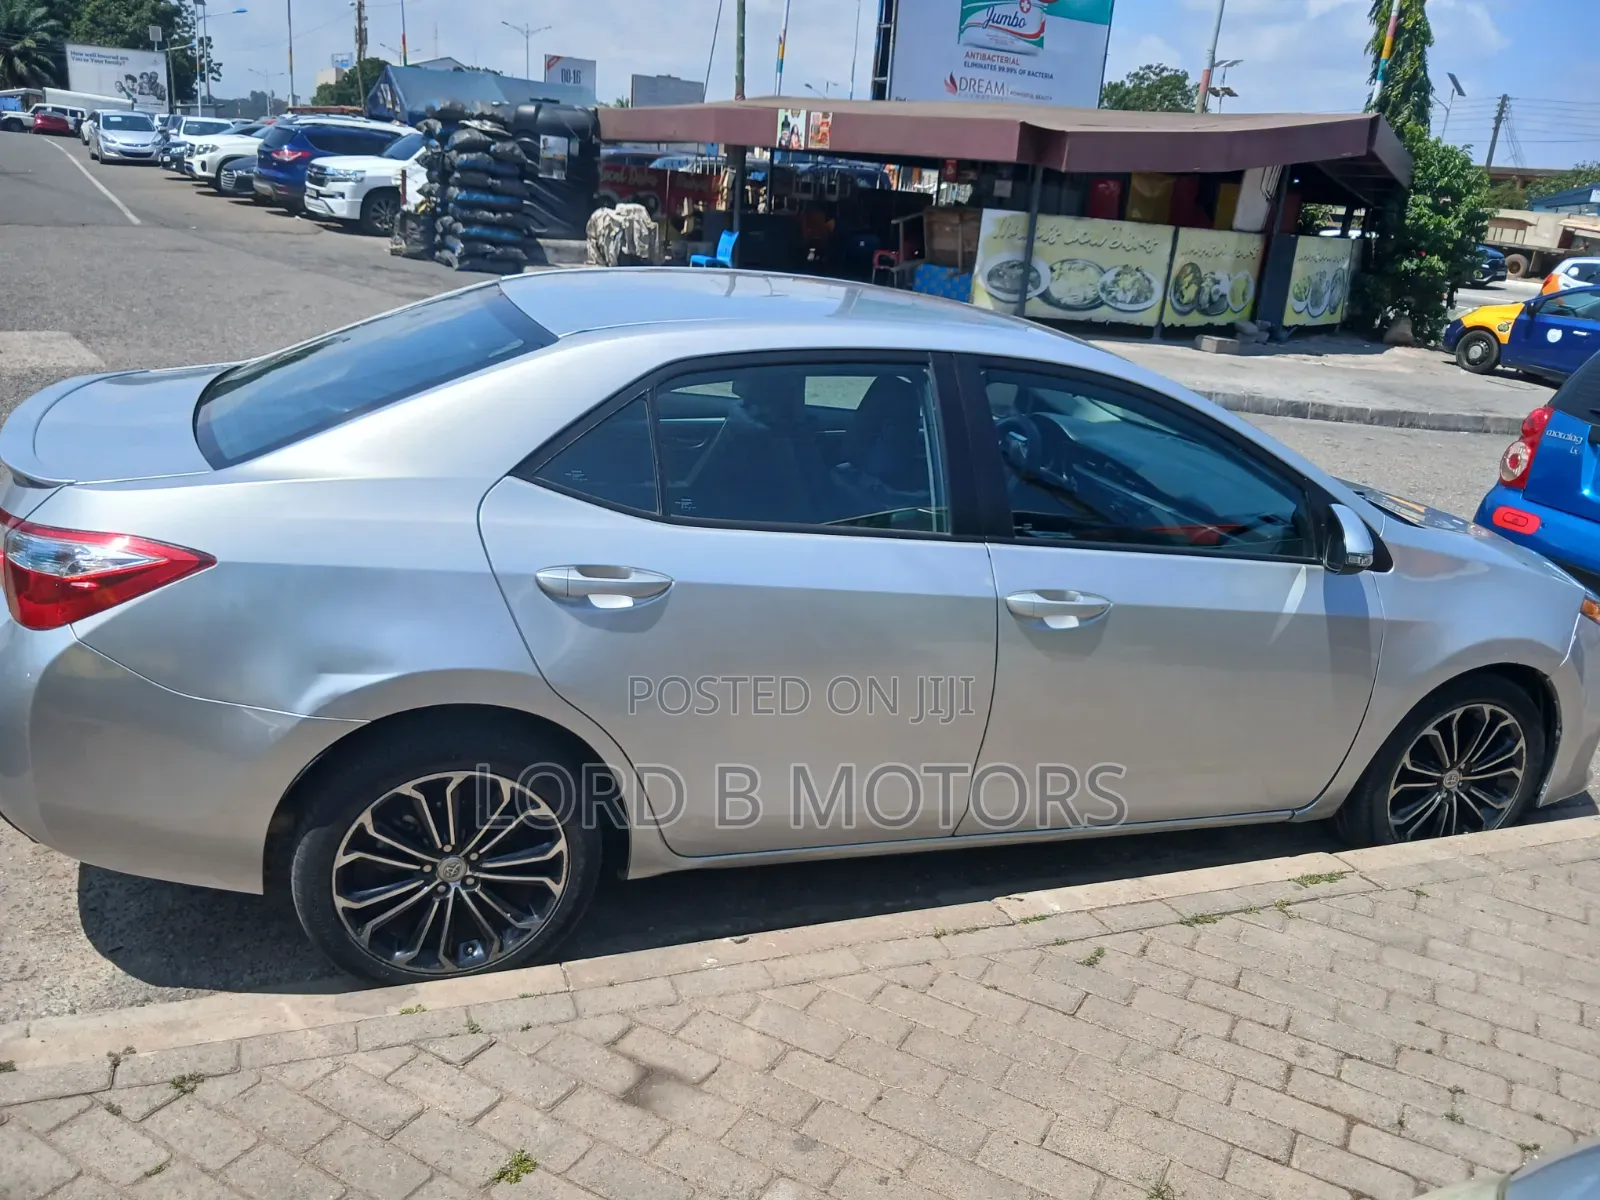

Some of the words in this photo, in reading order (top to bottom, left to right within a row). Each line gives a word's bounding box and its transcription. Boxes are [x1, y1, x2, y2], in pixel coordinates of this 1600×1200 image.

[982, 6, 1027, 29] Jumbo
[965, 51, 1020, 65] ANTIBACTERIAL
[964, 61, 997, 71] ELIMINATES
[997, 65, 1018, 74] 99.99%
[1027, 70, 1054, 80] BACTERIA
[958, 76, 1005, 96] DREAM
